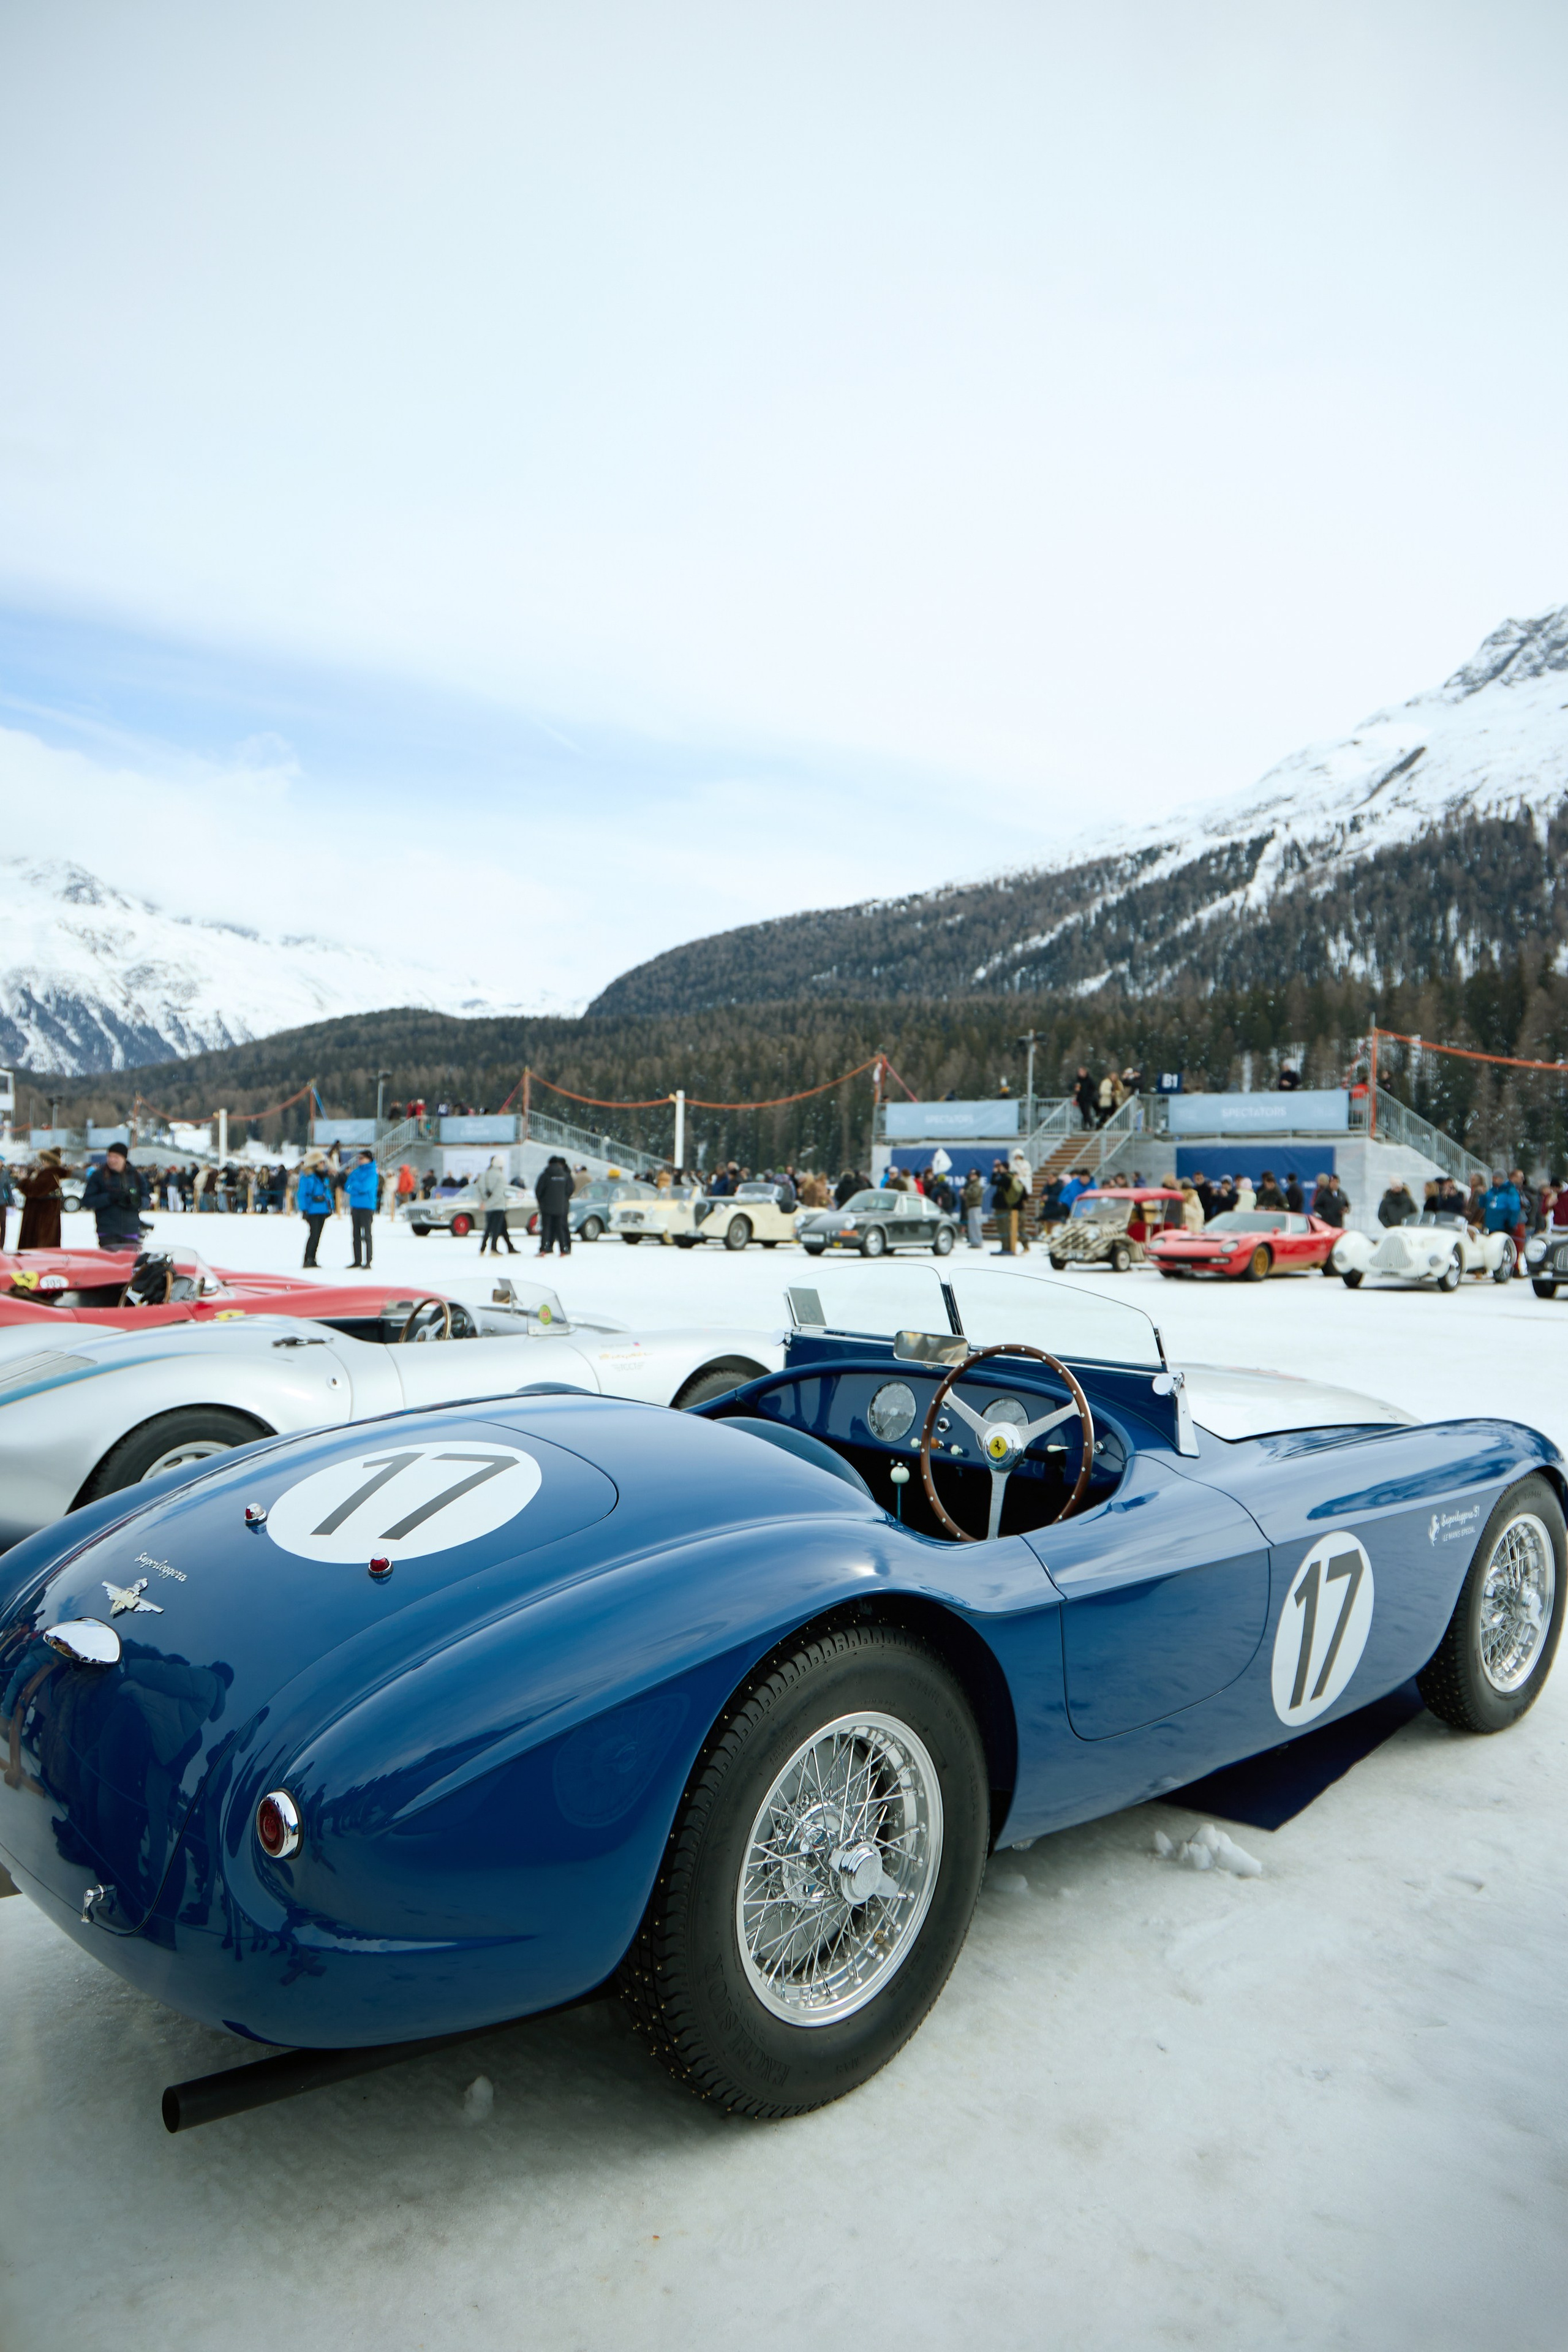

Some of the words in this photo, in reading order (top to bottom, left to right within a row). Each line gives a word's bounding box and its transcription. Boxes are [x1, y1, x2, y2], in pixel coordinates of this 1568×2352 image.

[1161, 1073, 1178, 1088] B1
[1221, 1106, 1286, 1118] SPECTATORS
[310, 1452, 520, 1540] 17
[1449, 1530, 1461, 1540] MANS
[134, 1551, 187, 1583] Superleggera
[1288, 1548, 1365, 1711] 17
[701, 1951, 793, 2092] EXCELSIOR
